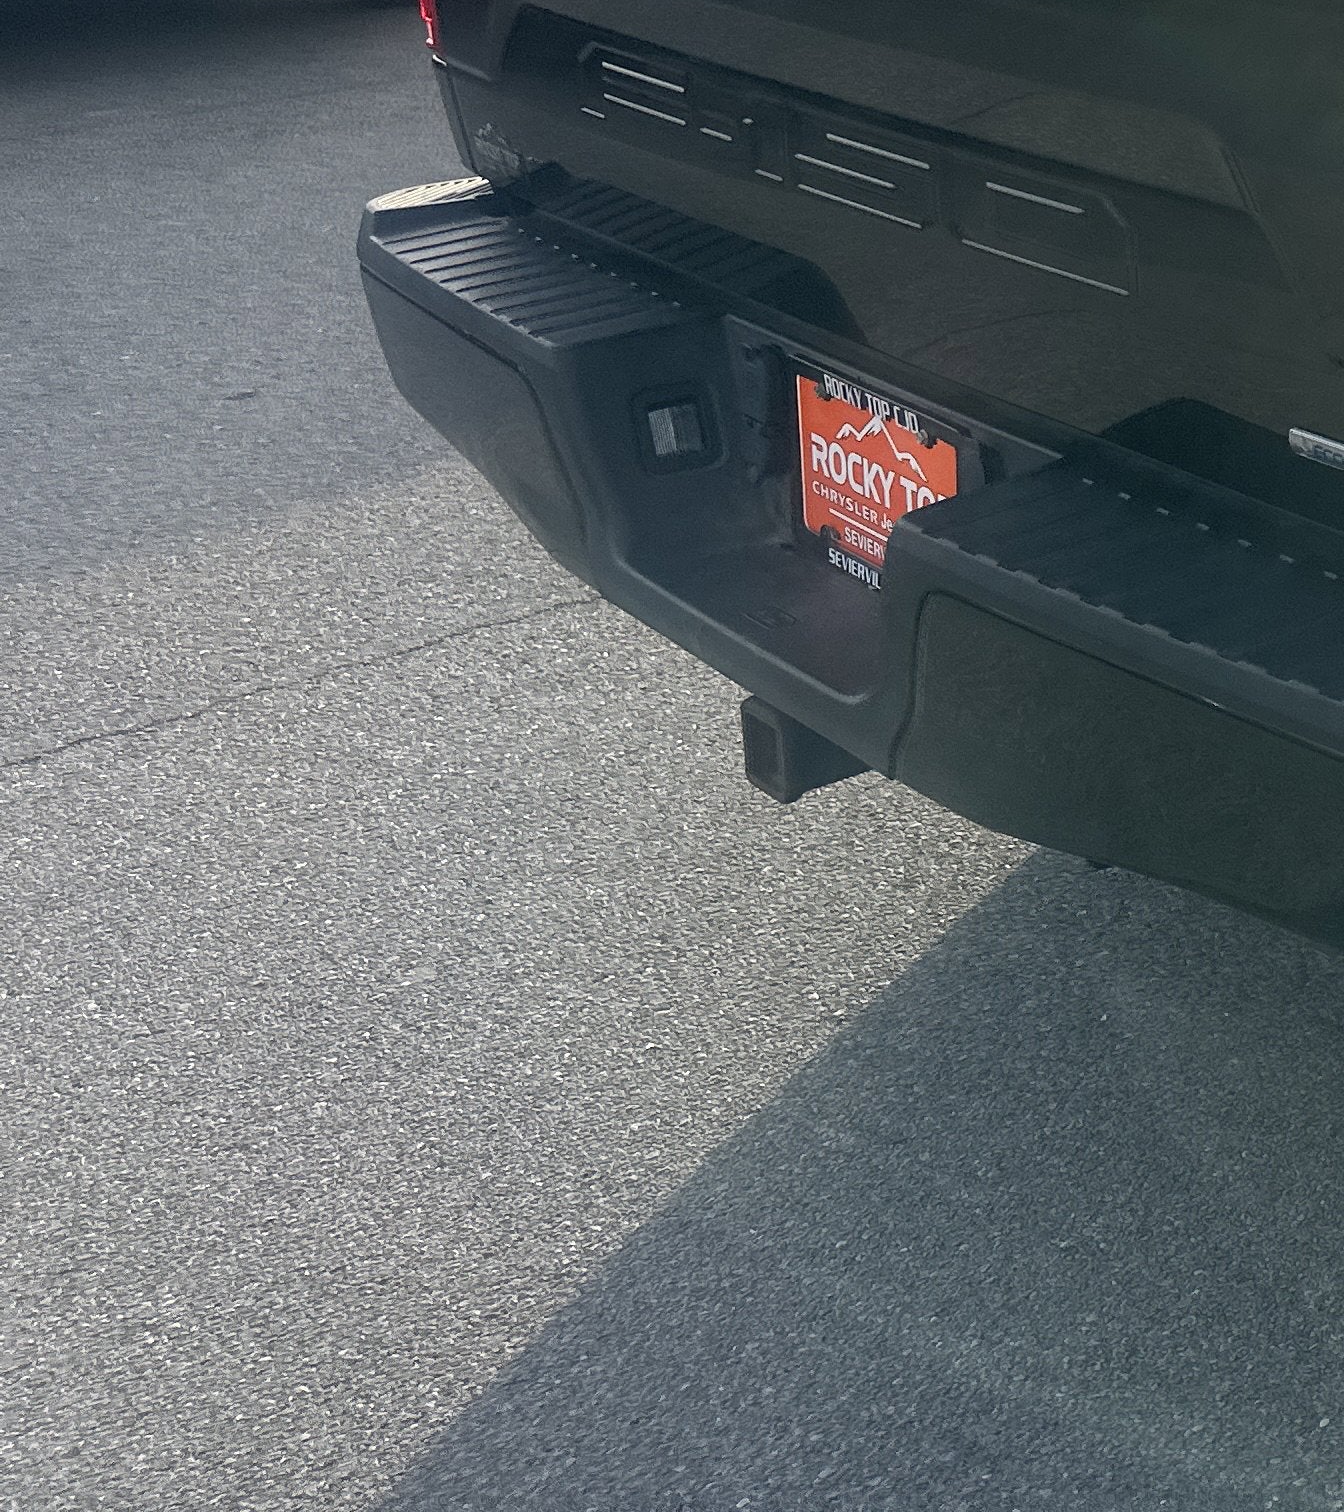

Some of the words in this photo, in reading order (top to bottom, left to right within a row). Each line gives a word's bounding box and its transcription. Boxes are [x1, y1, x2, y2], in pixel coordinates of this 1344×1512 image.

[823, 373, 862, 410] ROCKY
[865, 392, 891, 422] TOP
[810, 431, 896, 509] ROCKY
[900, 475, 947, 513] TO
[812, 479, 879, 527] CHRYSLER
